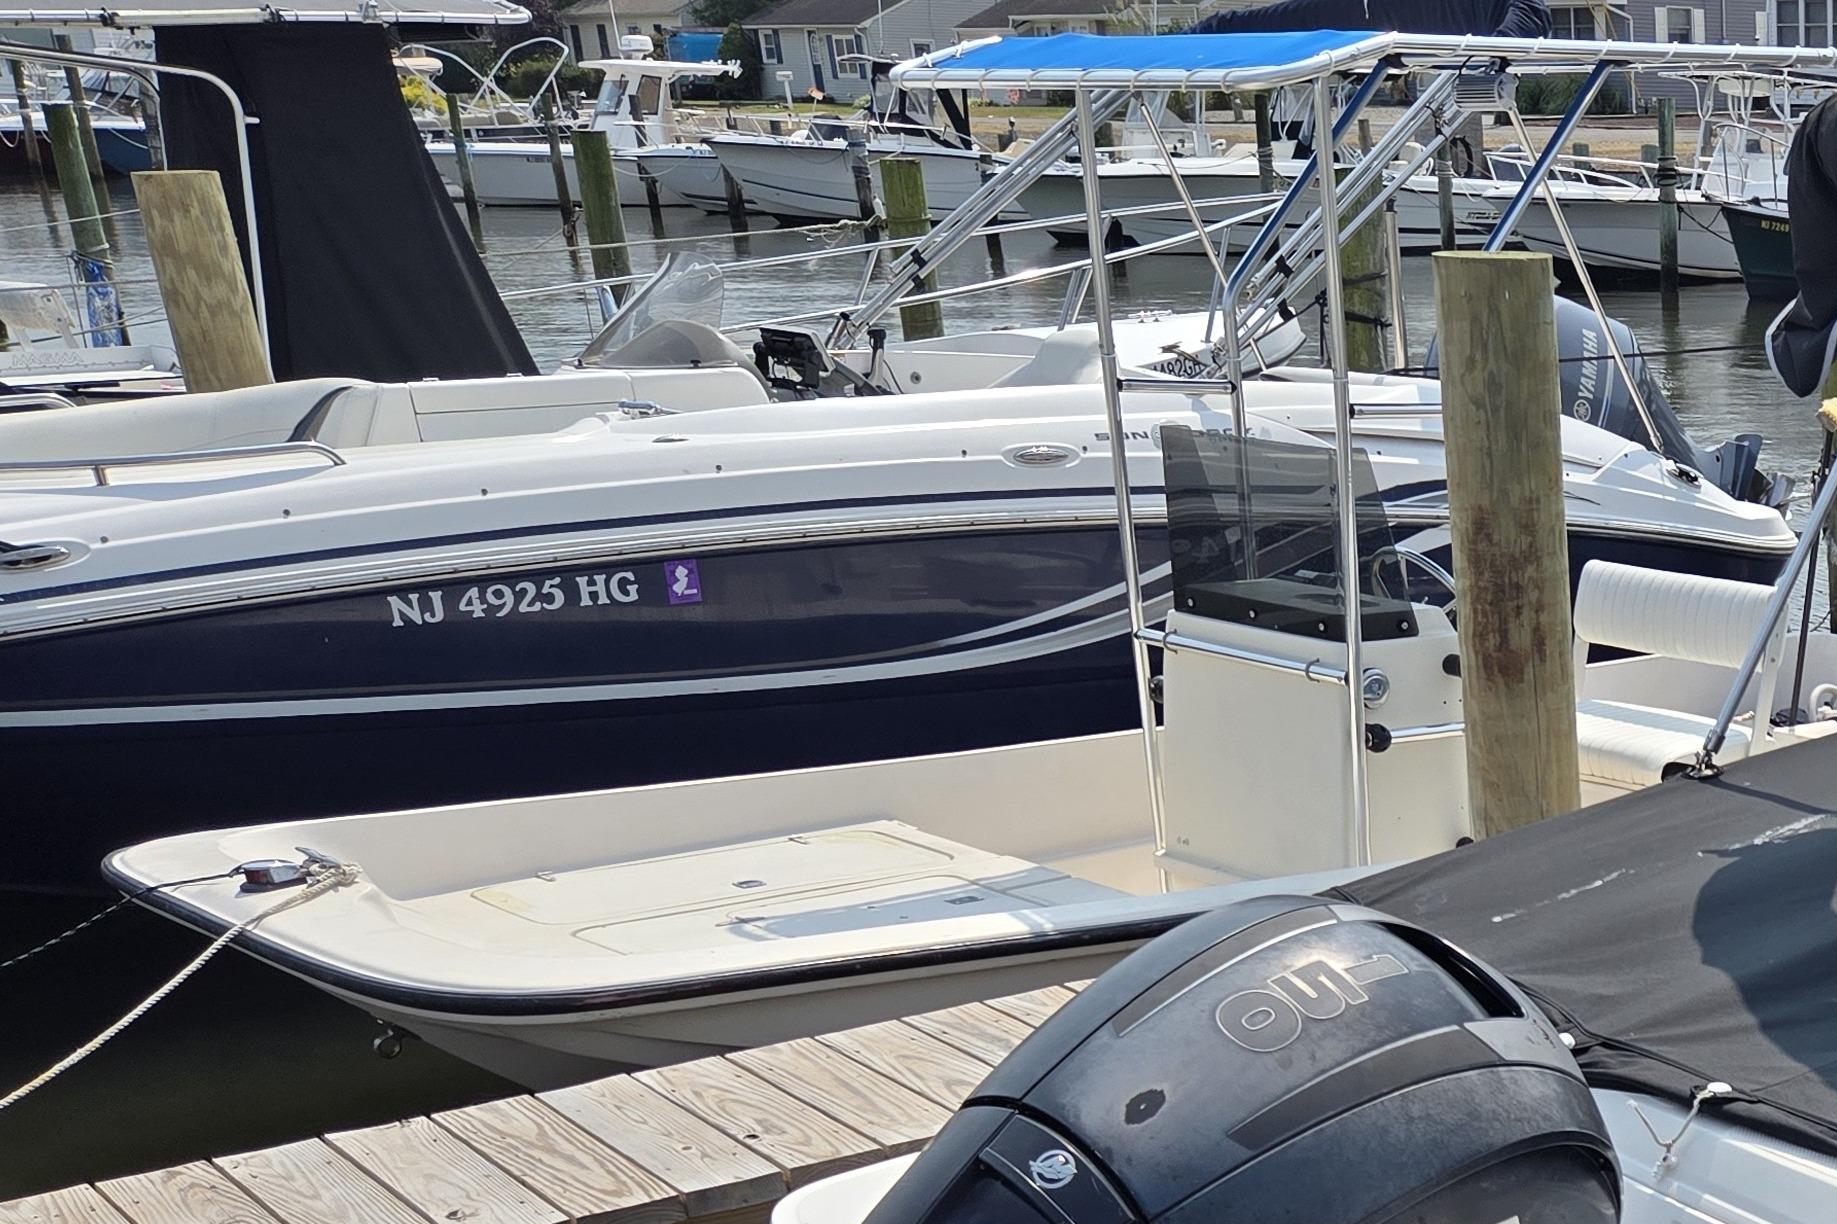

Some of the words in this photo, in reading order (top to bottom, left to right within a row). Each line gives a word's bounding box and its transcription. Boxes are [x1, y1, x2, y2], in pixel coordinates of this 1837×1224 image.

[1578, 328, 1598, 399] YAMAHA
[387, 590, 445, 627] NJ
[458, 576, 566, 618] 4925
[575, 571, 639, 607] HG
[1215, 953, 1410, 1052] 150
